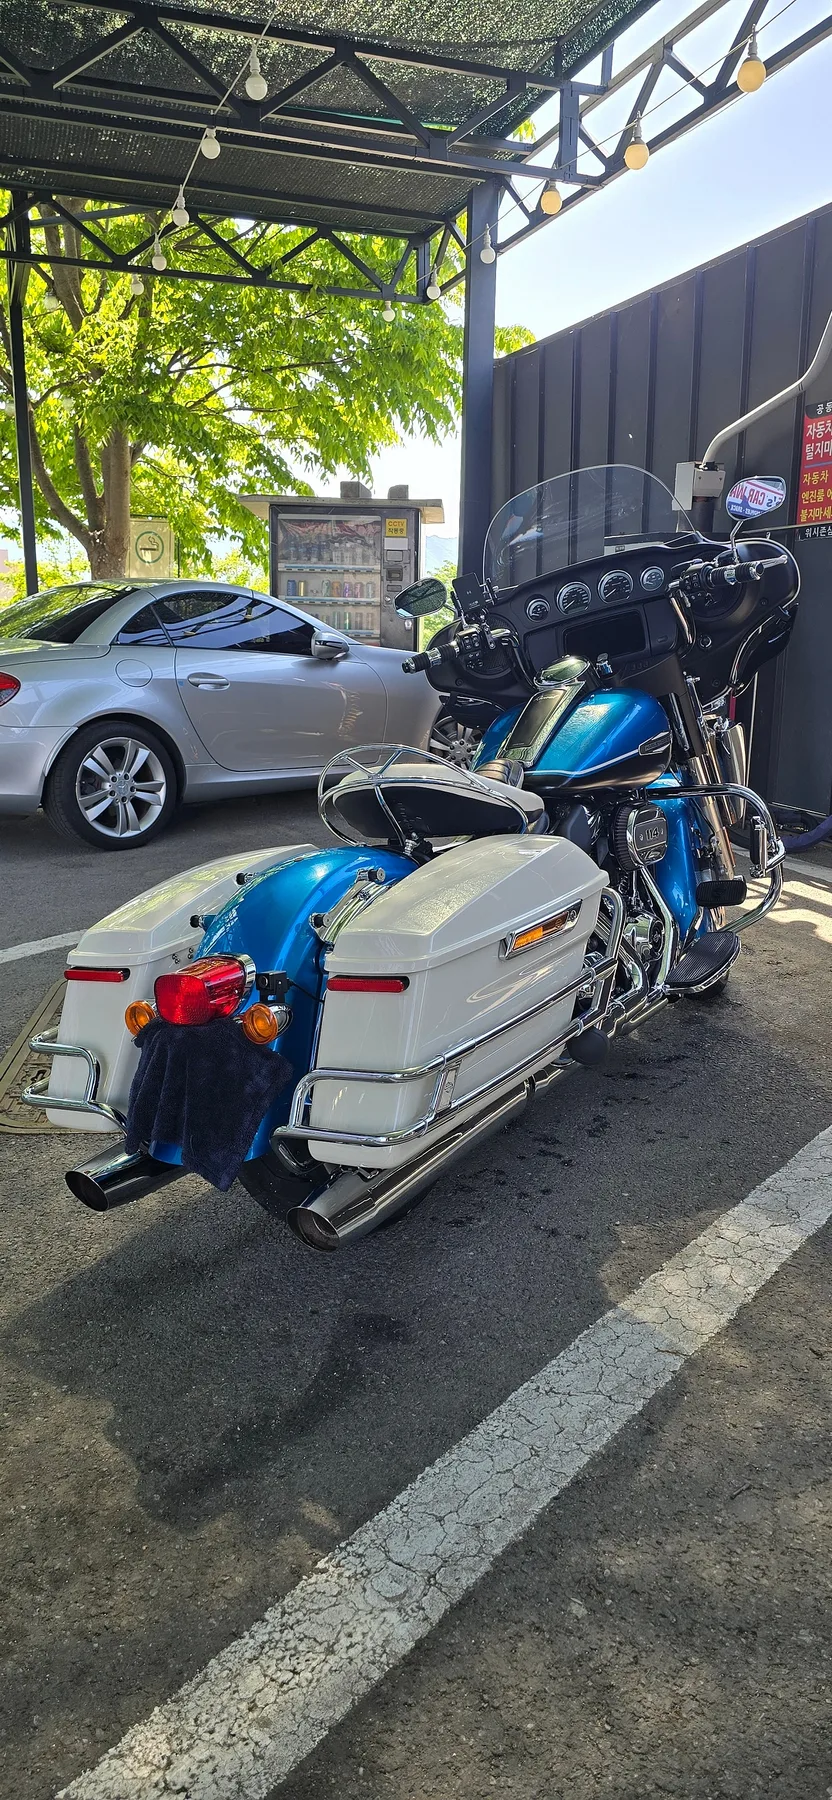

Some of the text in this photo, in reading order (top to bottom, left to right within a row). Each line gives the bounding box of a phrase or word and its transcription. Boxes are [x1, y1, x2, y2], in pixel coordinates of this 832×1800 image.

[803, 470, 829, 485] 자동차
[801, 488, 825, 504] 엔진룸
[800, 505, 832, 522] 불지마세
[646, 826, 660, 841] 114
